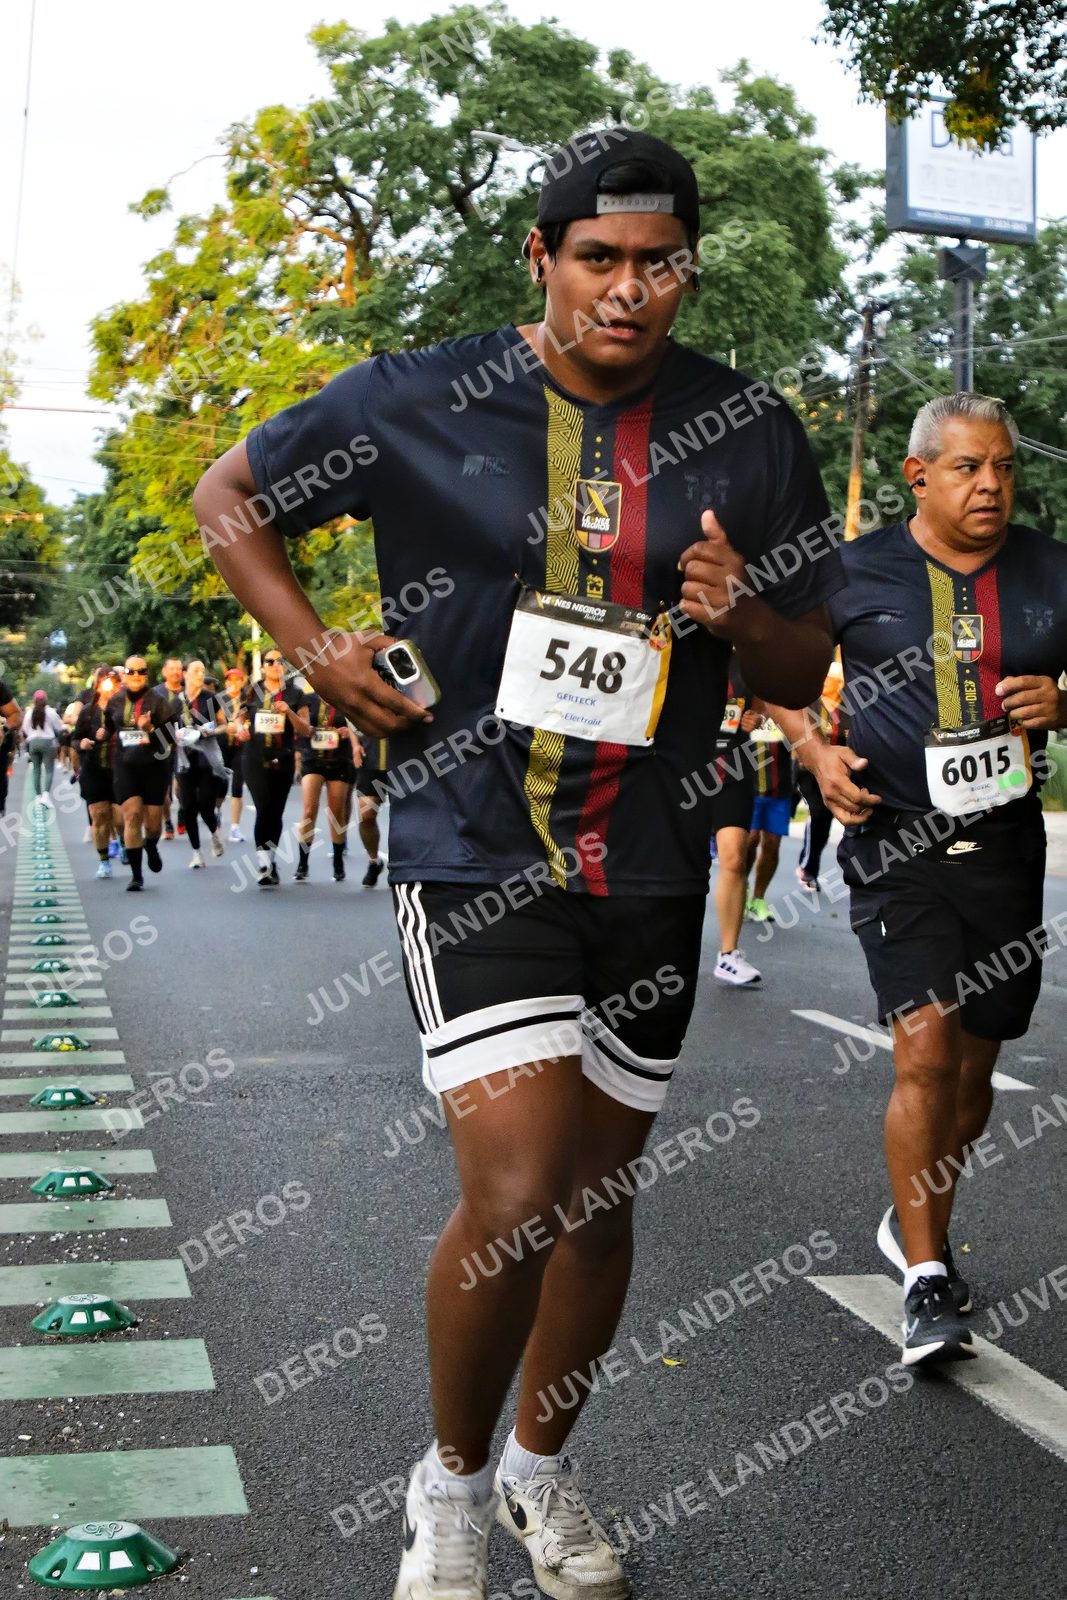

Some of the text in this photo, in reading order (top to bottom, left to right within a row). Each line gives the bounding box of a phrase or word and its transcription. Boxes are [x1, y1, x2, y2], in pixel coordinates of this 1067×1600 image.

[572, 602, 607, 617] NEGROS
[539, 638, 627, 694] 548
[942, 745, 1011, 786] 6015
[952, 840, 978, 850] NIKE
